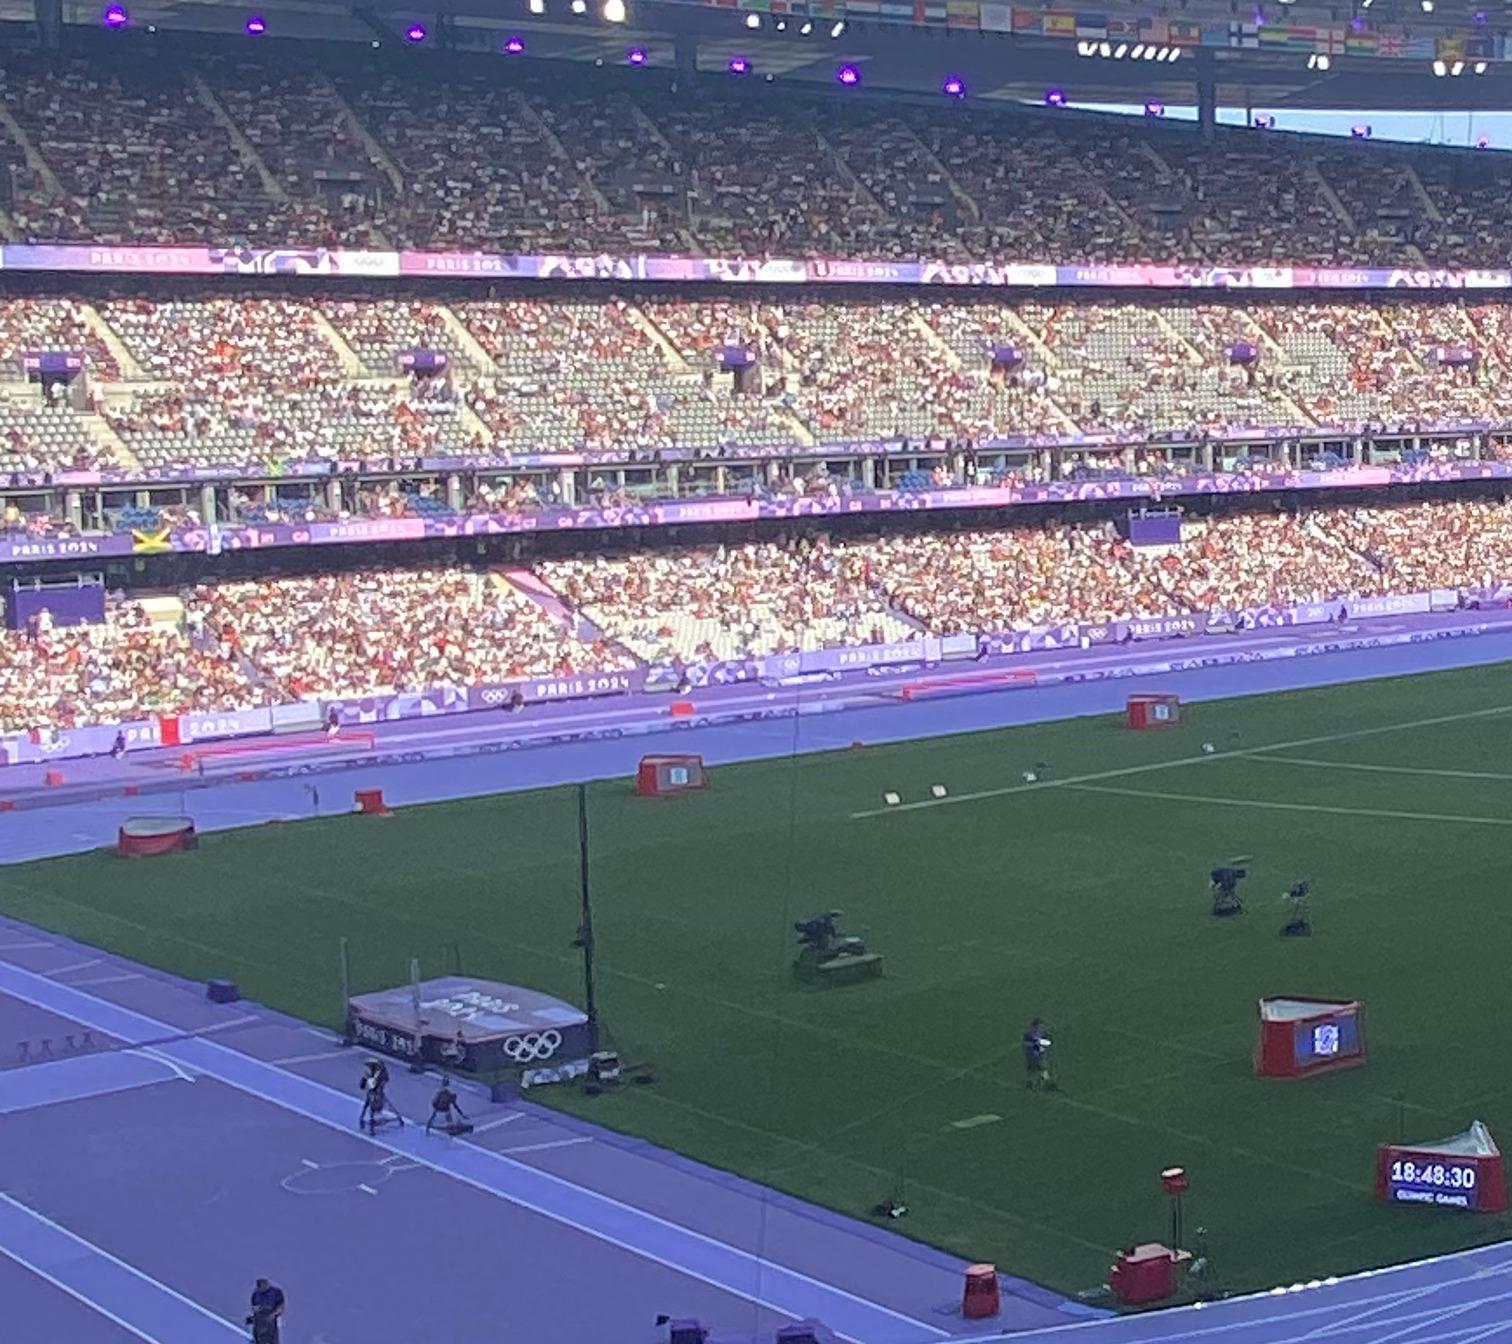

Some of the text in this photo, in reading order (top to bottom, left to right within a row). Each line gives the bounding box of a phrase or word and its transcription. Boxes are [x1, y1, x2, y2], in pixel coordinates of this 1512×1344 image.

[12, 542, 98, 556] PARIS 2024
[537, 675, 629, 697] PARIS 2024
[1391, 1161, 1475, 1188] 18:48:30
